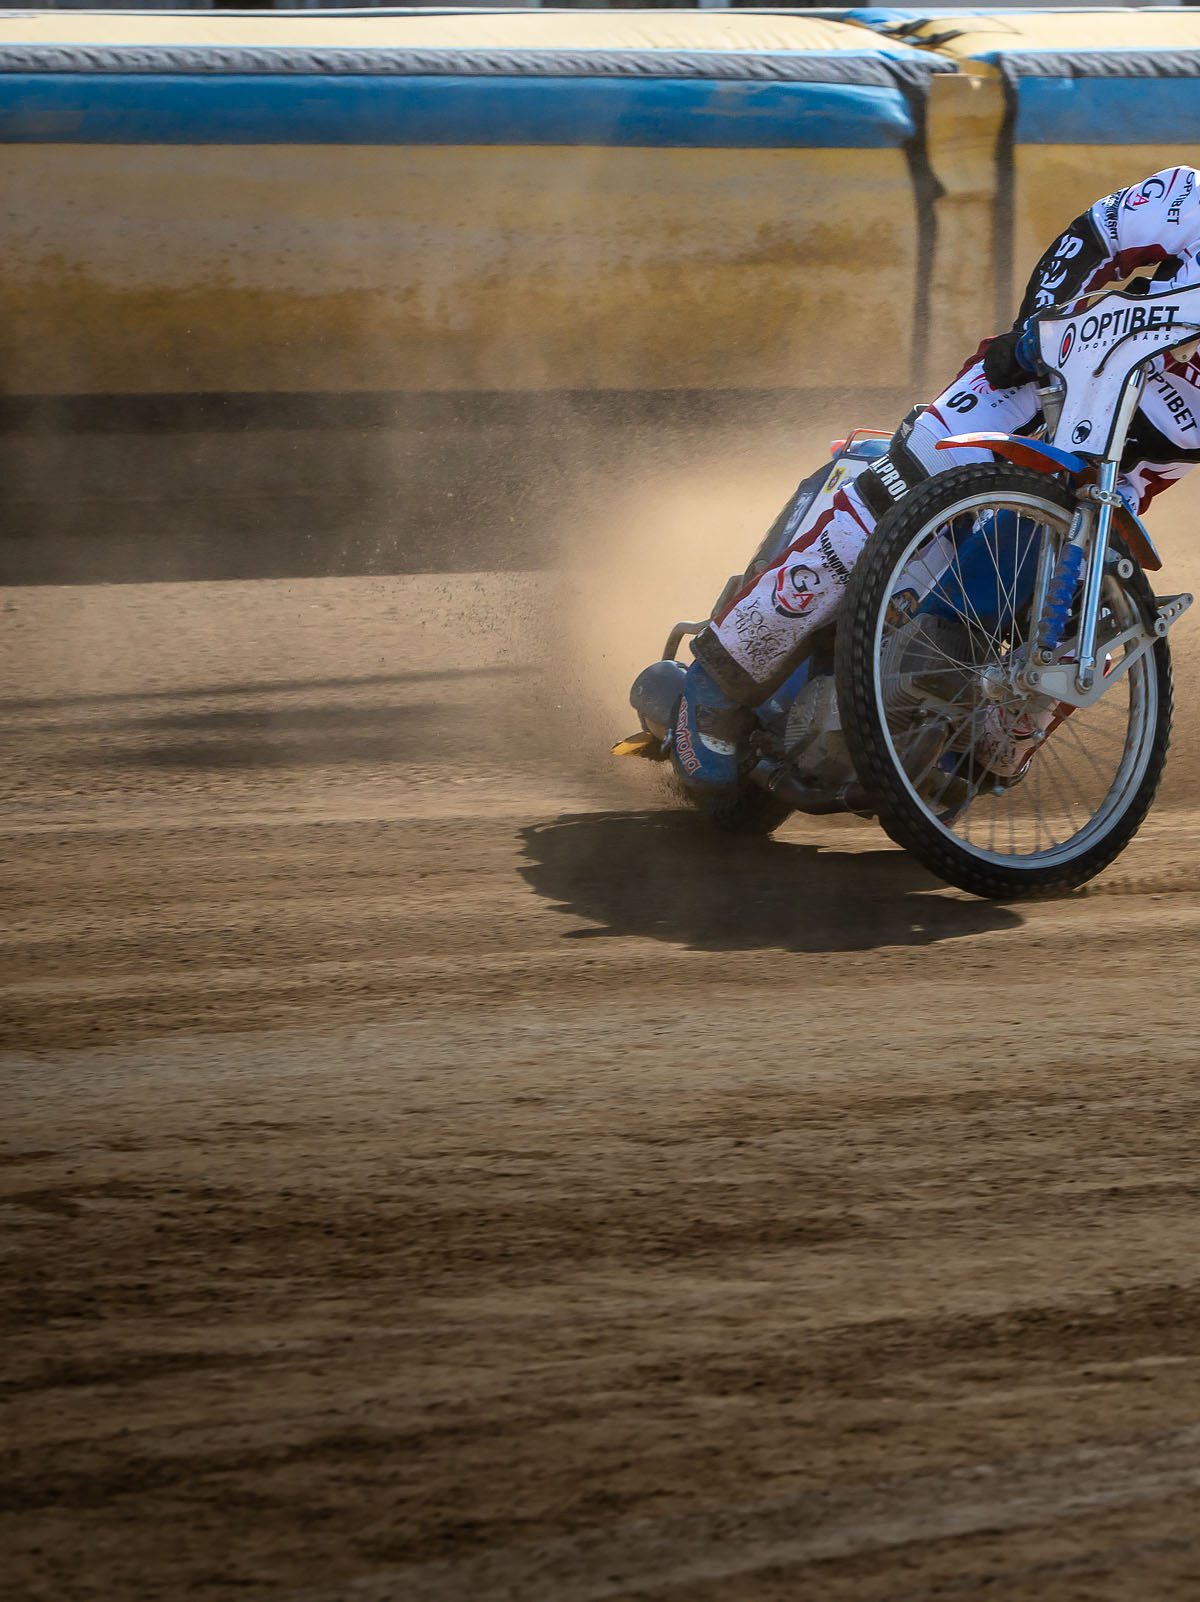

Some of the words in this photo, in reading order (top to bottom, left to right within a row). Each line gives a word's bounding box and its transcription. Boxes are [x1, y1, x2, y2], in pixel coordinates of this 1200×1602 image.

[1166, 171, 1195, 225] OPTIBET
[1078, 338, 1116, 352] SPORT
[1080, 306, 1180, 342] OPTIBET
[1147, 360, 1198, 433] OPTIBET
[820, 529, 851, 585] BARANOWS
